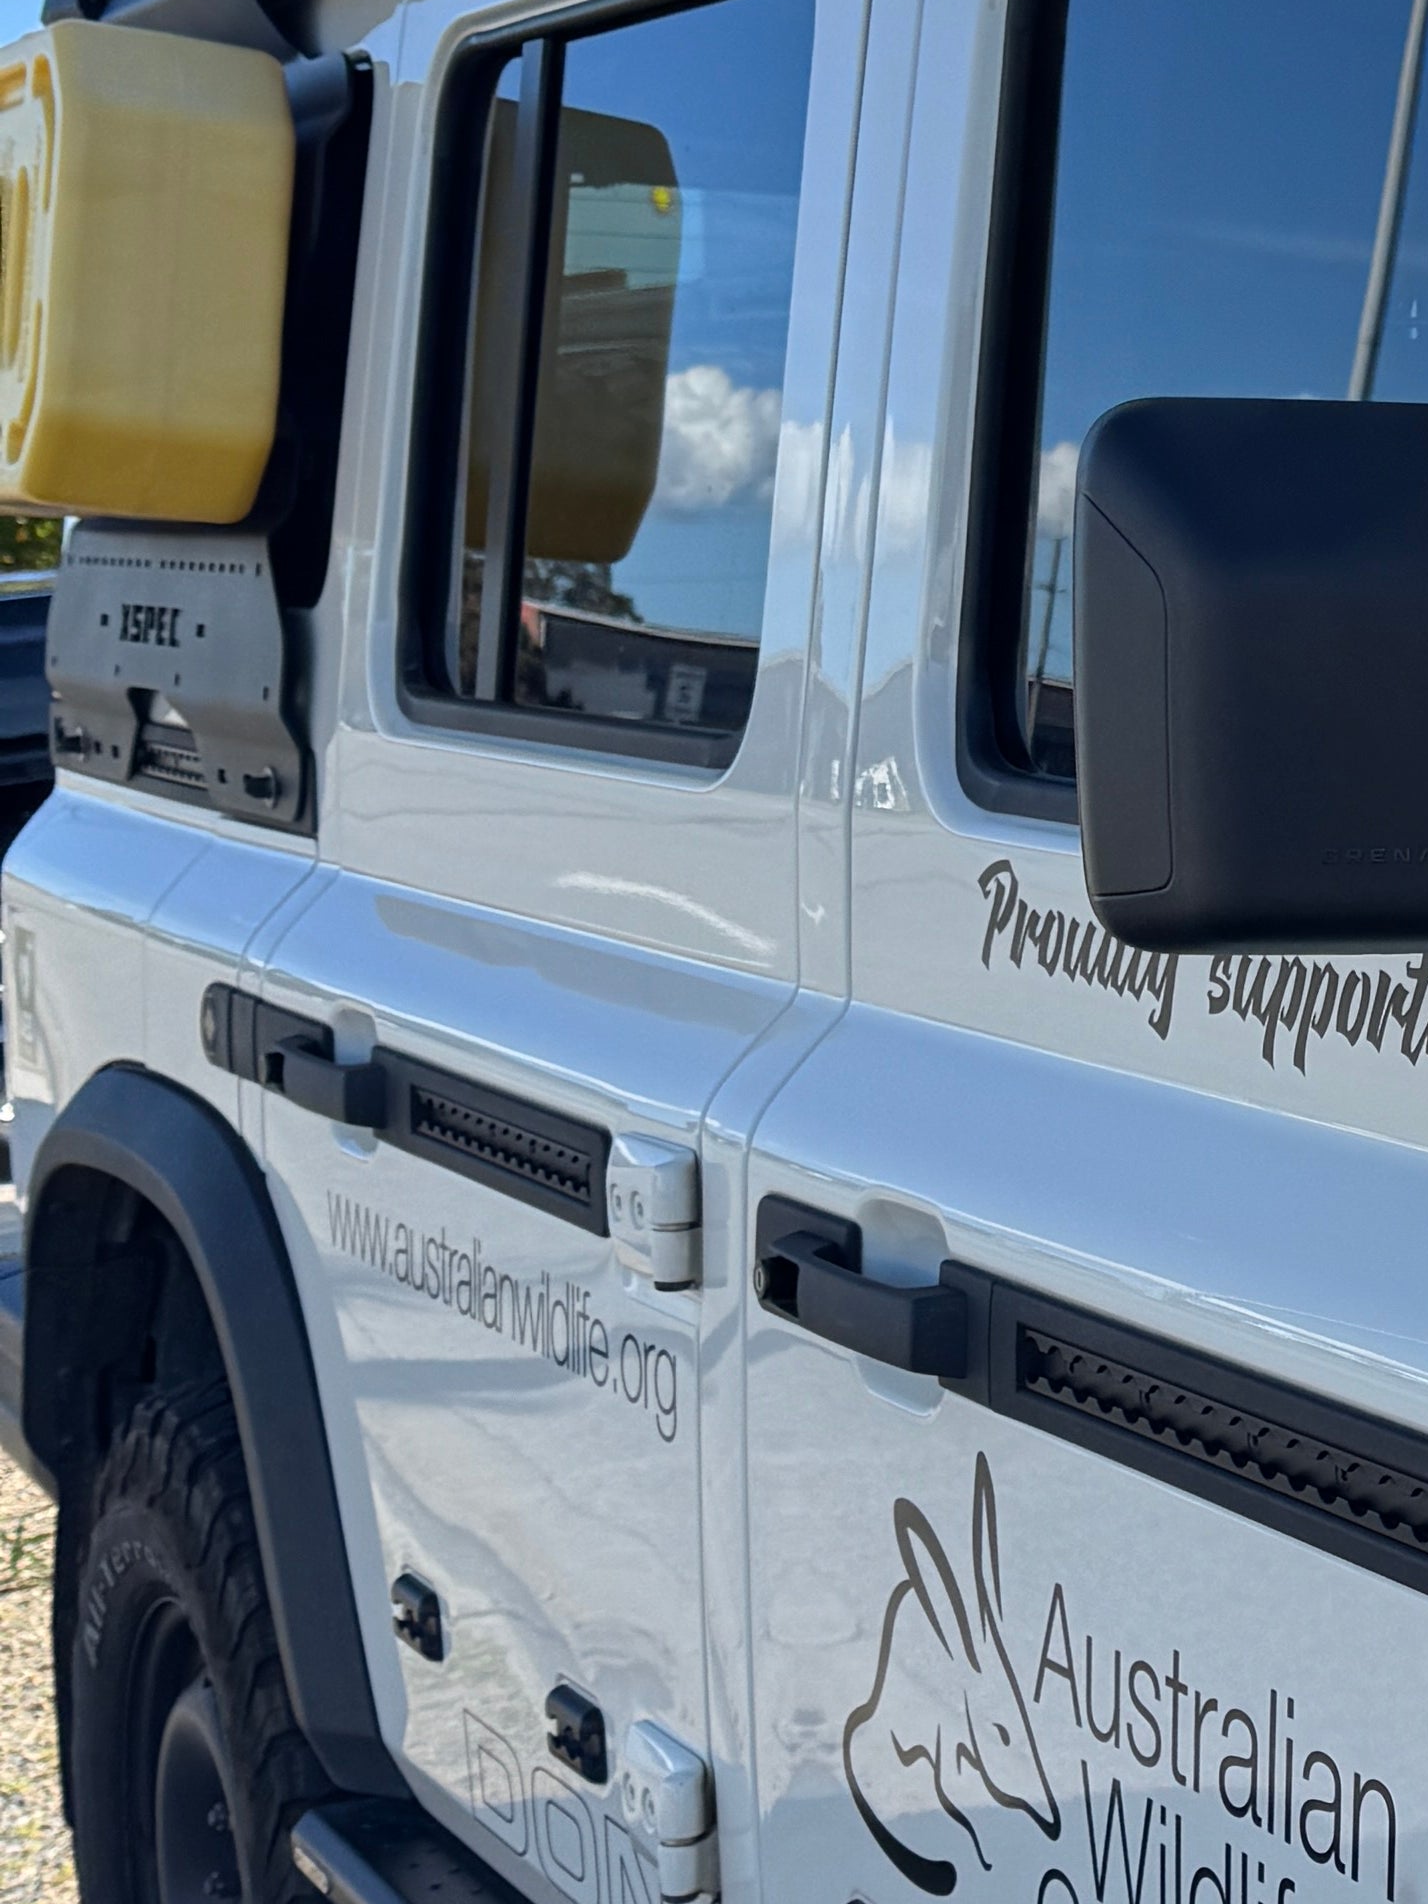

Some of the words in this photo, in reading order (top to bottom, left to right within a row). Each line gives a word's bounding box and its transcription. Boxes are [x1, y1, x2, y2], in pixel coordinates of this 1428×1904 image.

[118, 603, 184, 648] XSPEC
[327, 1189, 678, 1442] www.australianwildlife.org
[1034, 1582, 1398, 1902] Australian
